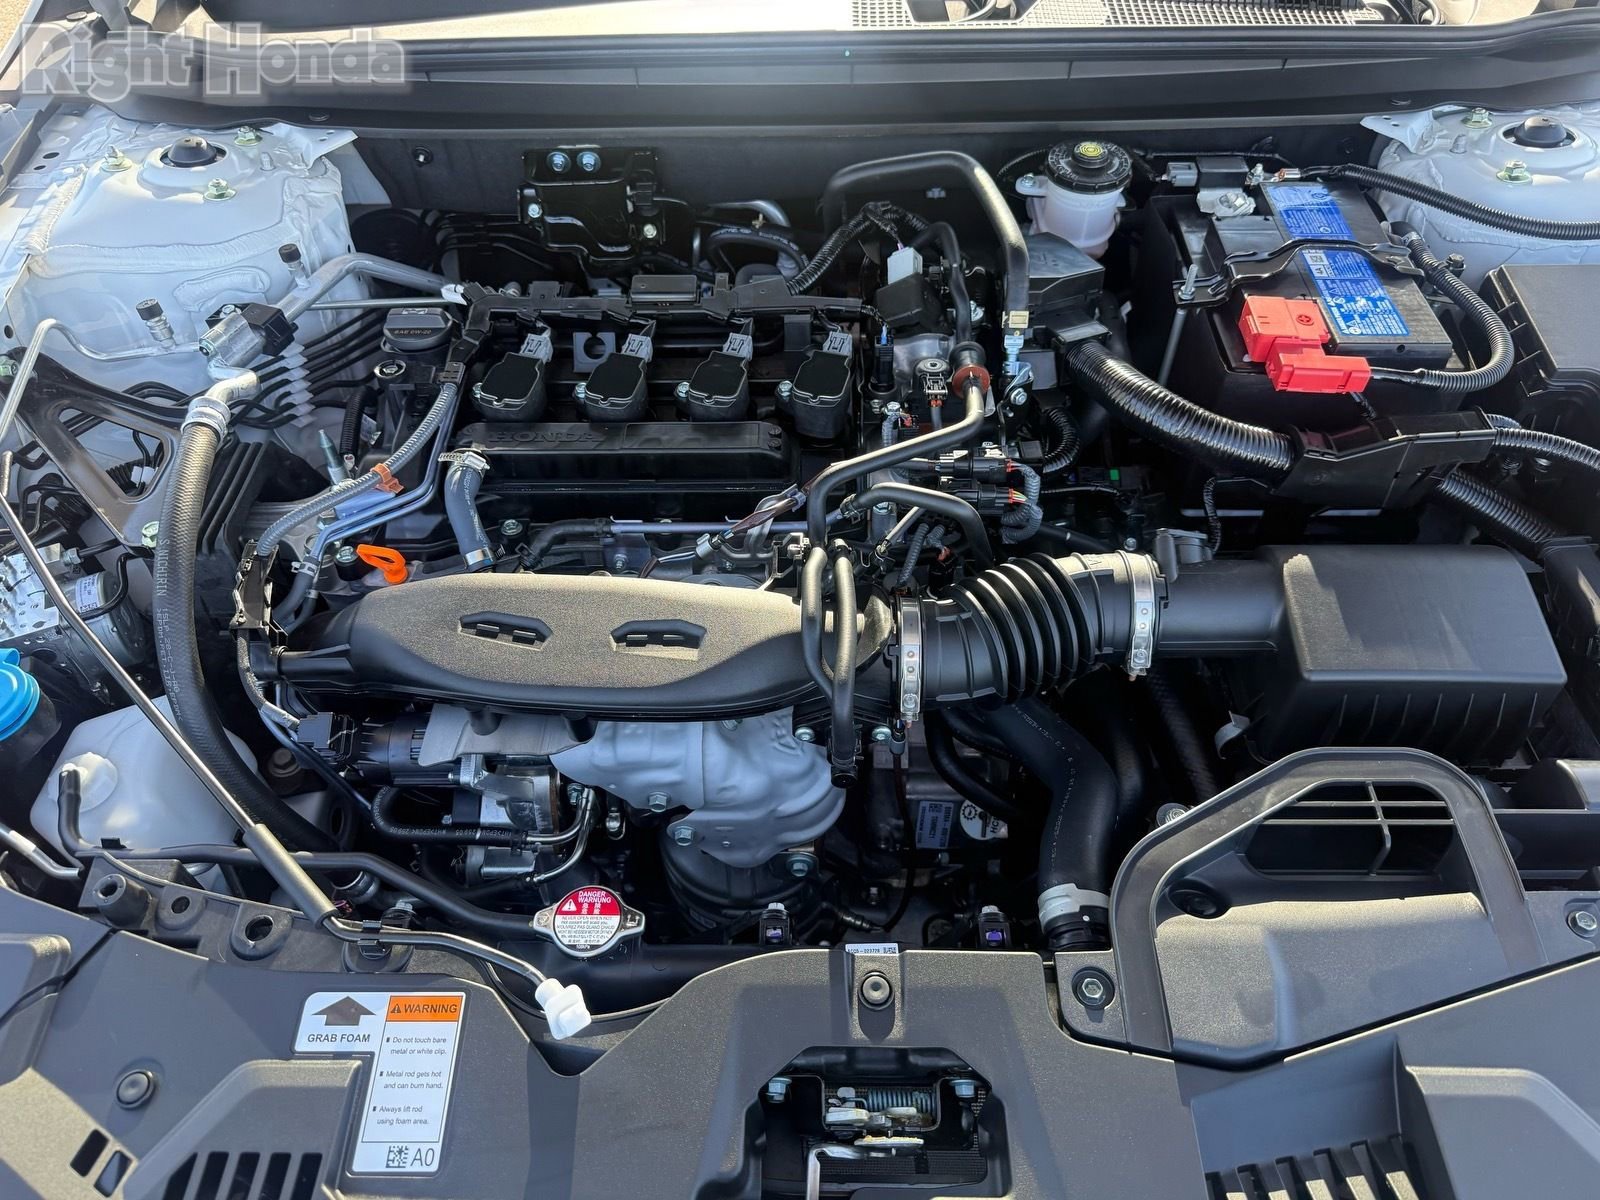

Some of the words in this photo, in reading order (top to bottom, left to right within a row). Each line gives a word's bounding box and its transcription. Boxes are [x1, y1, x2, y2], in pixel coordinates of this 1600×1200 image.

[487, 431, 606, 443] HONDA
[156, 549, 169, 596] NICHIRIN
[404, 1003, 458, 1014] WARNING
[307, 1033, 338, 1043] GRAB
[340, 1033, 371, 1043] FOAM
[416, 1070, 430, 1078] gets
[379, 1105, 402, 1113] Always
[411, 1148, 435, 1167] A0
